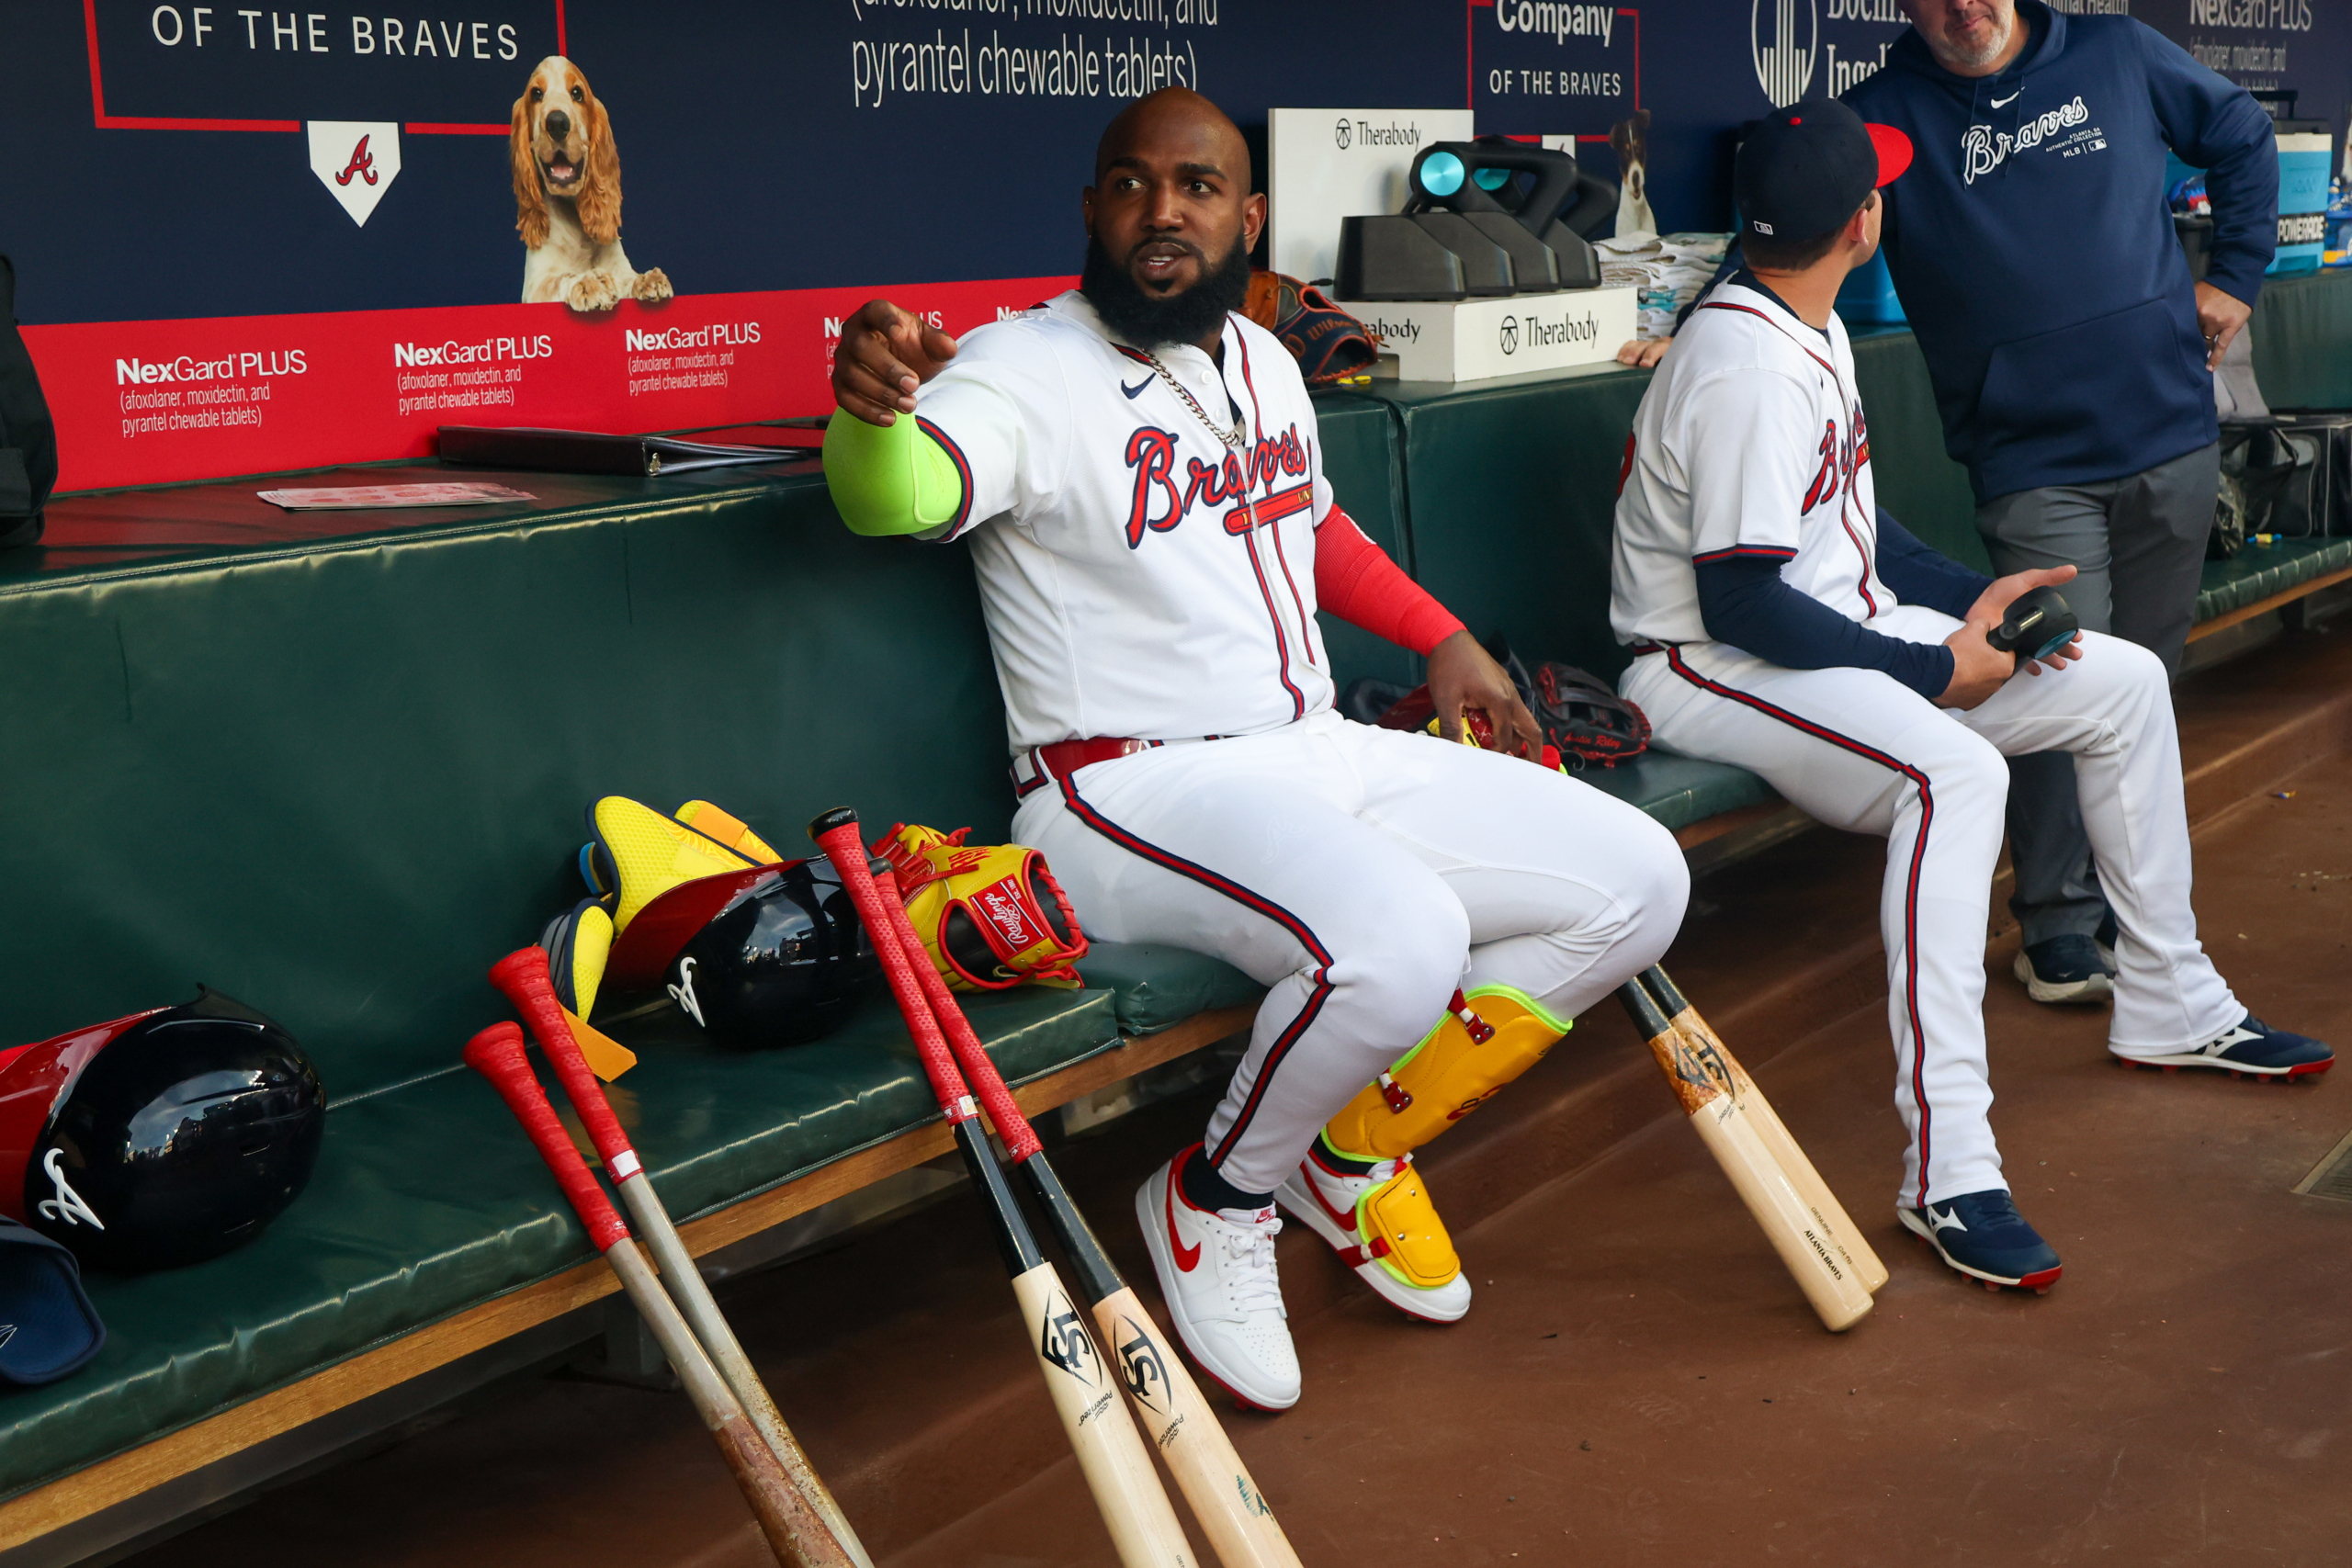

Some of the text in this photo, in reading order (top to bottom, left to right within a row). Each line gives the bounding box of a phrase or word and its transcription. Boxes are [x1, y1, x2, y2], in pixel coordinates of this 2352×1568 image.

[1497, 0, 1613, 47] Company
[2269, 0, 2312, 31] PLUS
[152, 5, 518, 61] OF THE BRAVES
[853, 28, 1197, 107] pyrantel chewable tablets)
[1489, 69, 1621, 96] OF THE BRAVES
[1357, 121, 1420, 153] Therabody
[1962, 96, 2089, 185] Braves
[2045, 140, 2073, 152] AUTHENTIC
[2063, 147, 2080, 159] MLB
[2278, 215, 2325, 243] POWERADE
[625, 321, 762, 352] NexGard PLUS
[1525, 310, 1600, 349] Therabody
[394, 334, 553, 367] NexGard PLUS
[719, 348, 734, 366] and
[116, 349, 308, 386] NexGard PLUS
[397, 364, 522, 395] (afoxolaner, moxidectin, and
[628, 368, 729, 397] pyrantel chewable tablets)
[119, 381, 270, 414] (afoxolaner, moxidectin, and
[399, 386, 514, 416] pyrantel chewable tablets)
[121, 404, 263, 438] pyrantel chewable tablets)
[1125, 422, 1306, 550] Braves
[984, 893, 1029, 944] Rawlings
[1804, 1229, 1844, 1280] ATLANTA BRAVES
